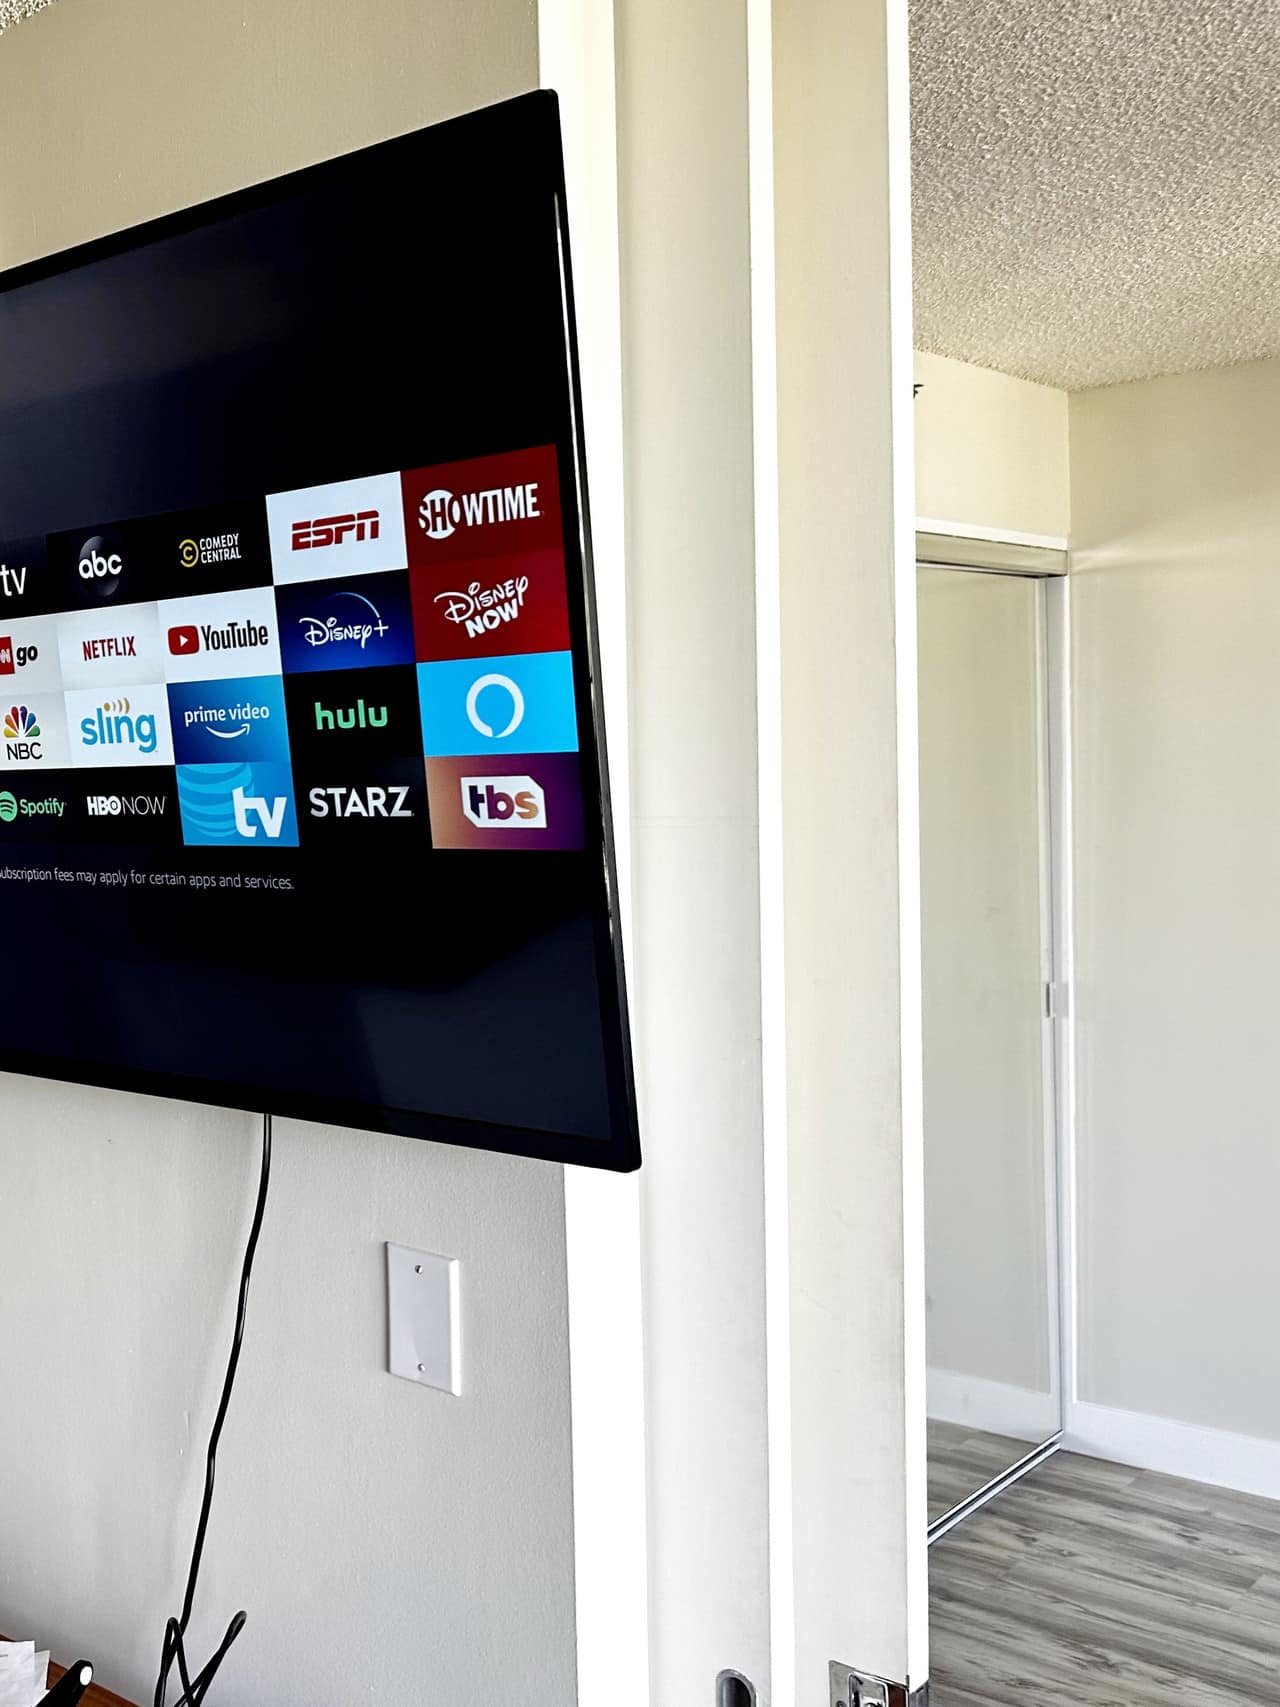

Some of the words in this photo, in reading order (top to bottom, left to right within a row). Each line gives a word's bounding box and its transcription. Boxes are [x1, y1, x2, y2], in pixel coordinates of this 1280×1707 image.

[419, 482, 540, 539] SHOWTIME
[199, 532, 240, 551] COMEDY
[291, 509, 380, 551] ESPN
[78, 550, 123, 579] abc
[200, 546, 243, 565] CENTRAL
[0, 564, 27, 597] tv
[201, 620, 269, 651] YouTube
[465, 603, 520, 639] NOW
[16, 644, 38, 667] go
[82, 636, 137, 662] NETFLIX
[80, 702, 157, 753] sling
[184, 706, 225, 728] prime
[229, 703, 270, 723] video
[315, 700, 388, 731] hulu
[6, 742, 43, 760] NBC
[20, 797, 64, 817] Spotify
[231, 785, 287, 838] tv
[309, 785, 412, 818] STARZ
[468, 785, 540, 820] tbs
[54, 867, 74, 881] fees
[76, 870, 97, 886] may
[99, 869, 128, 887] apply
[130, 869, 147, 884] for
[149, 871, 186, 887] certain
[189, 874, 217, 889] apps
[219, 873, 241, 888] and
[244, 875, 295, 890] services.
